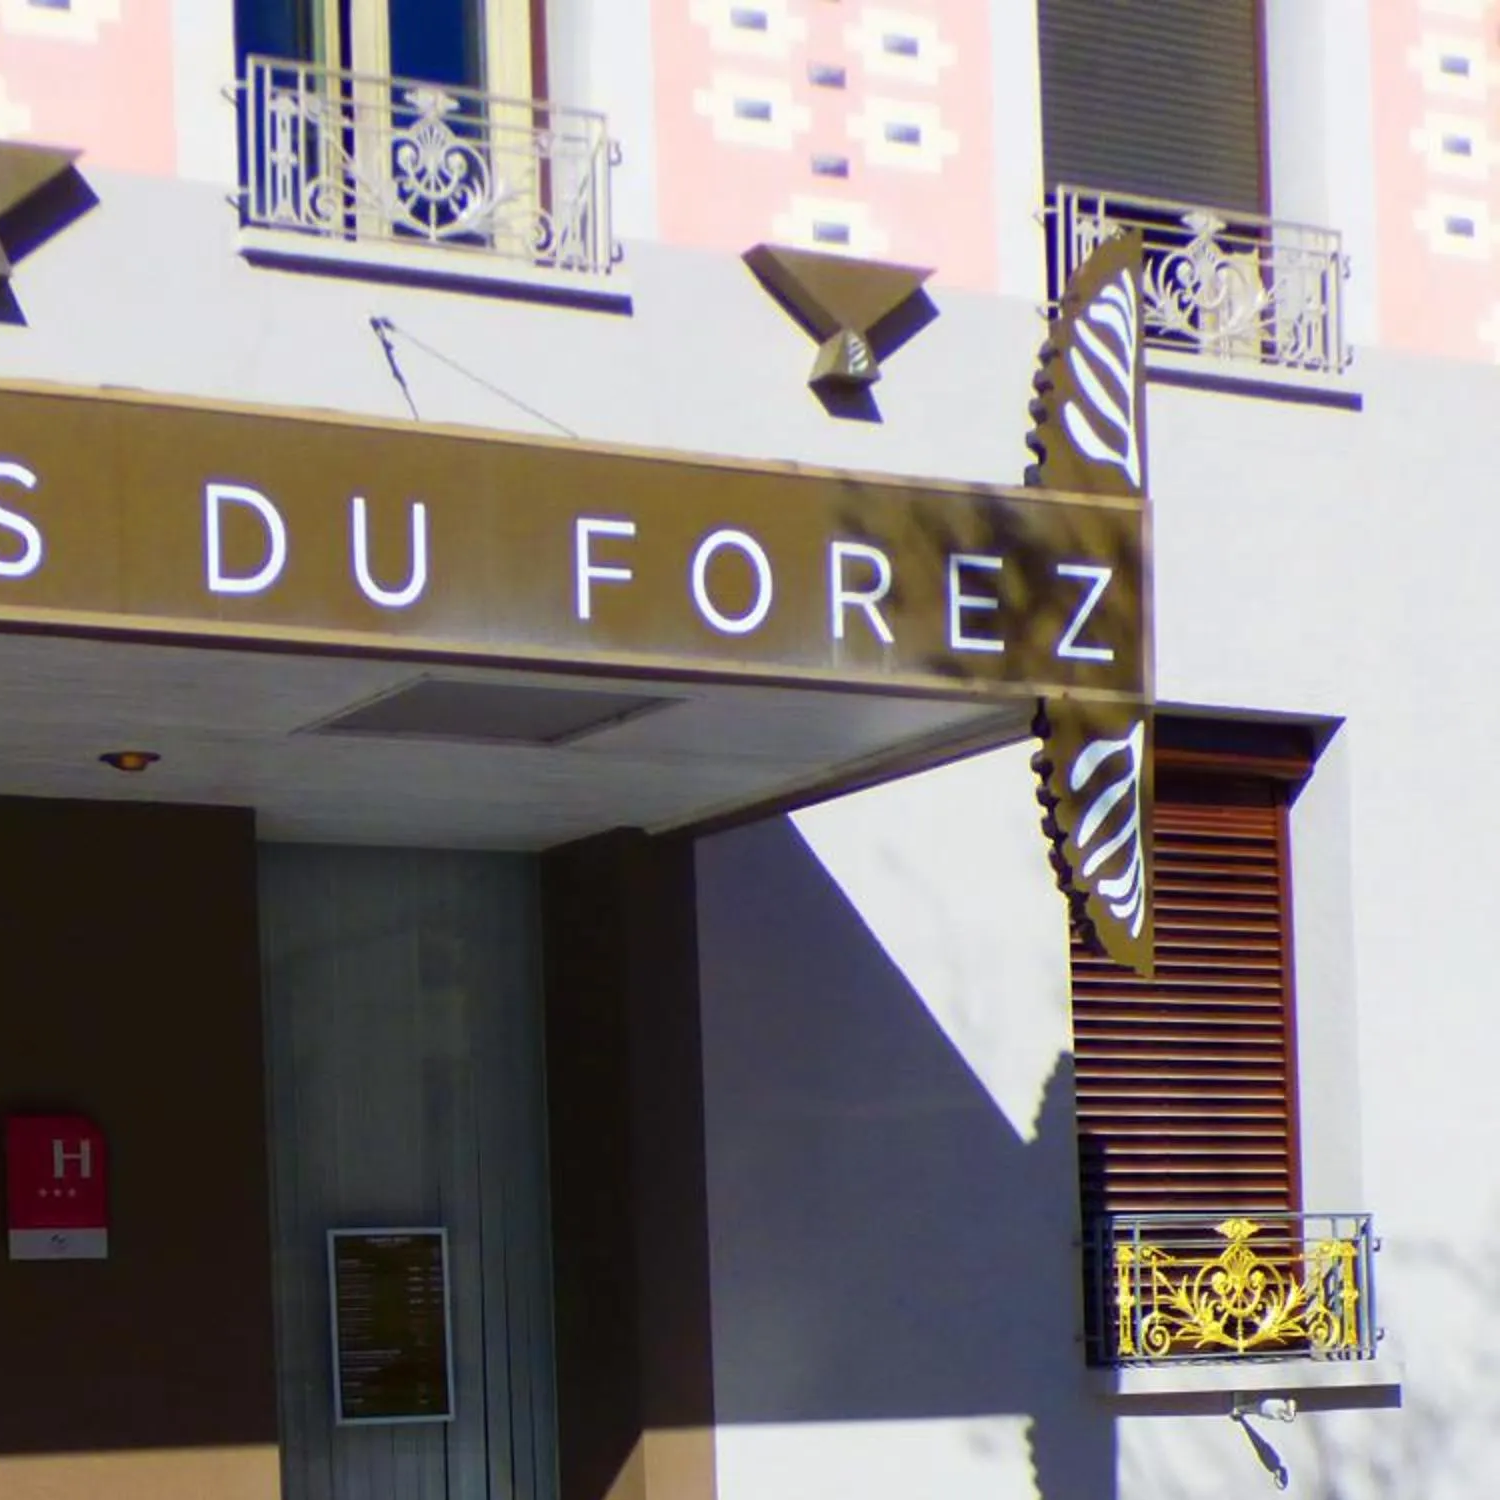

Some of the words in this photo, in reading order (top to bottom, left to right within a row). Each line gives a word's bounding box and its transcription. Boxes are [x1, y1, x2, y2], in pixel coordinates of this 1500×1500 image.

[206, 483, 427, 607] DU
[575, 517, 1114, 662] FOREZ
[51, 1138, 92, 1179] H
